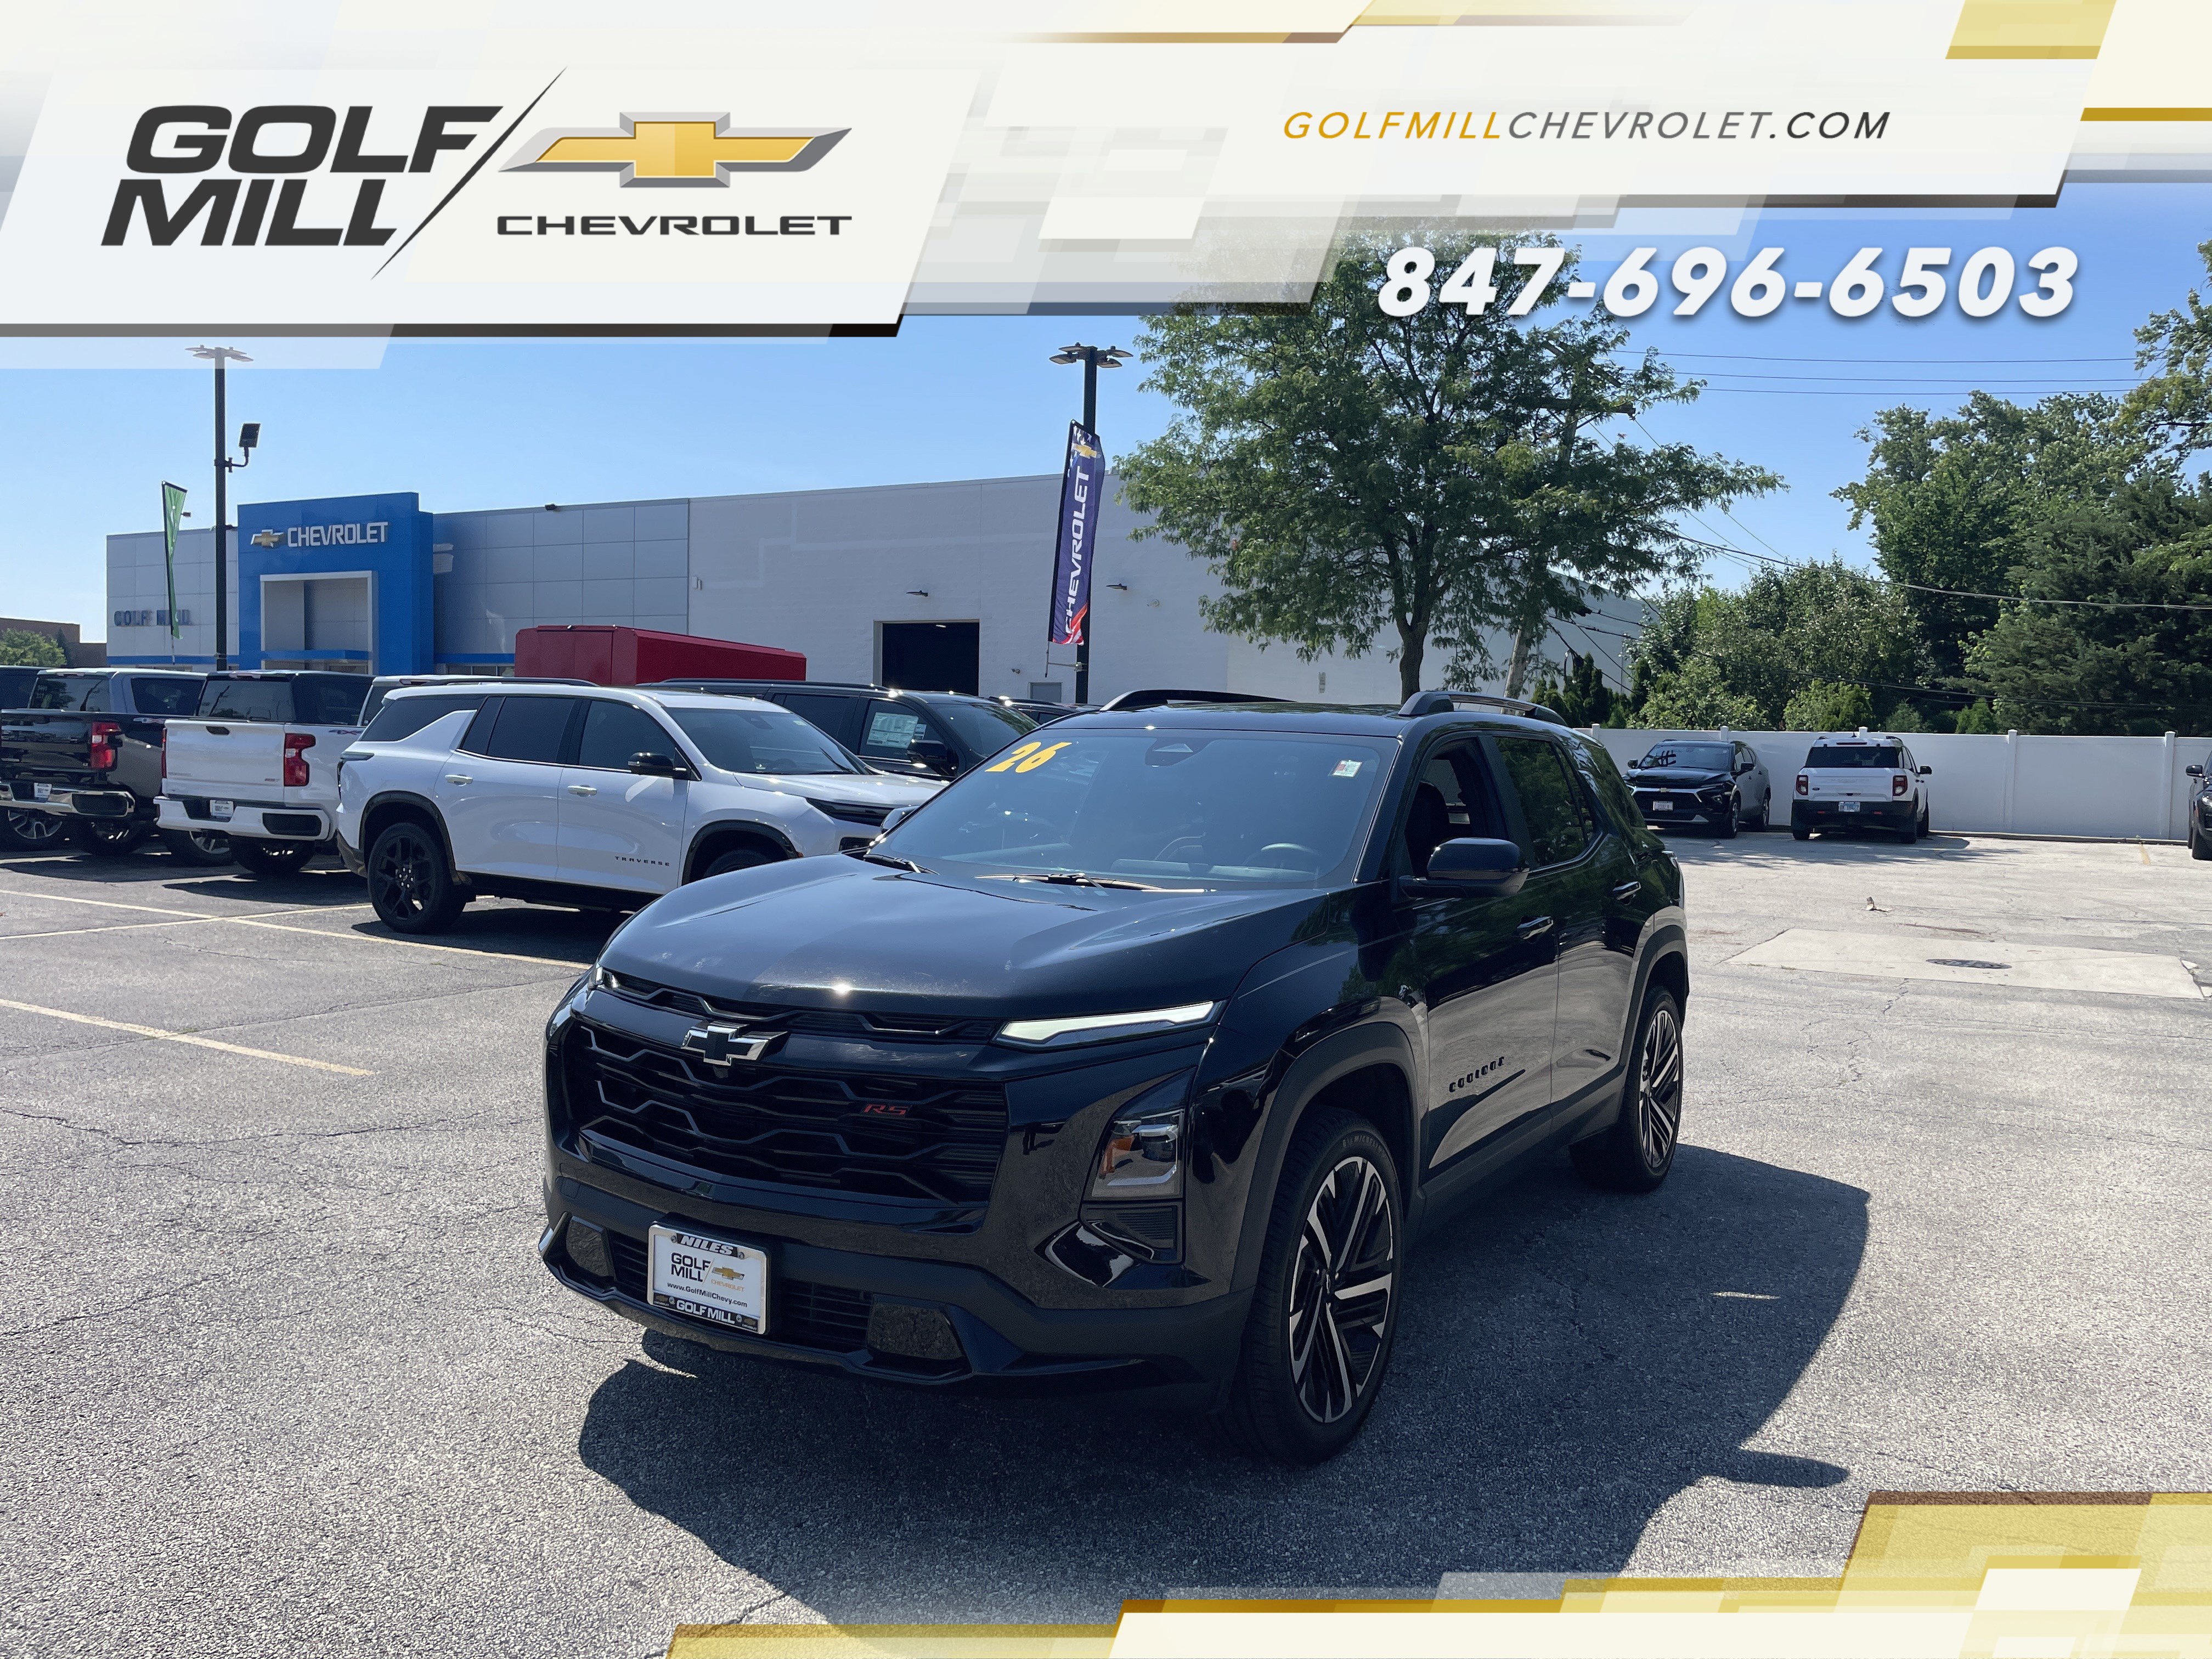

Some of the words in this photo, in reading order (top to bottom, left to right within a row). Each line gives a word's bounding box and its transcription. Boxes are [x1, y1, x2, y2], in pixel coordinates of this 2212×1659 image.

[286, 521, 388, 548] CHEVROLET
[1065, 465, 1090, 634] CHEVROLET
[985, 742, 1072, 773] 26
[614, 856, 670, 866] TRAVERSE
[864, 1103, 908, 1116] RS
[680, 1235, 733, 1255] NILES
[670, 1252, 711, 1271] GOLF
[670, 1263, 703, 1283] MILL
[667, 1281, 748, 1308] www.GolfMillChevy.com
[676, 1299, 708, 1316] GOLF
[707, 1307, 735, 1324] MILL
